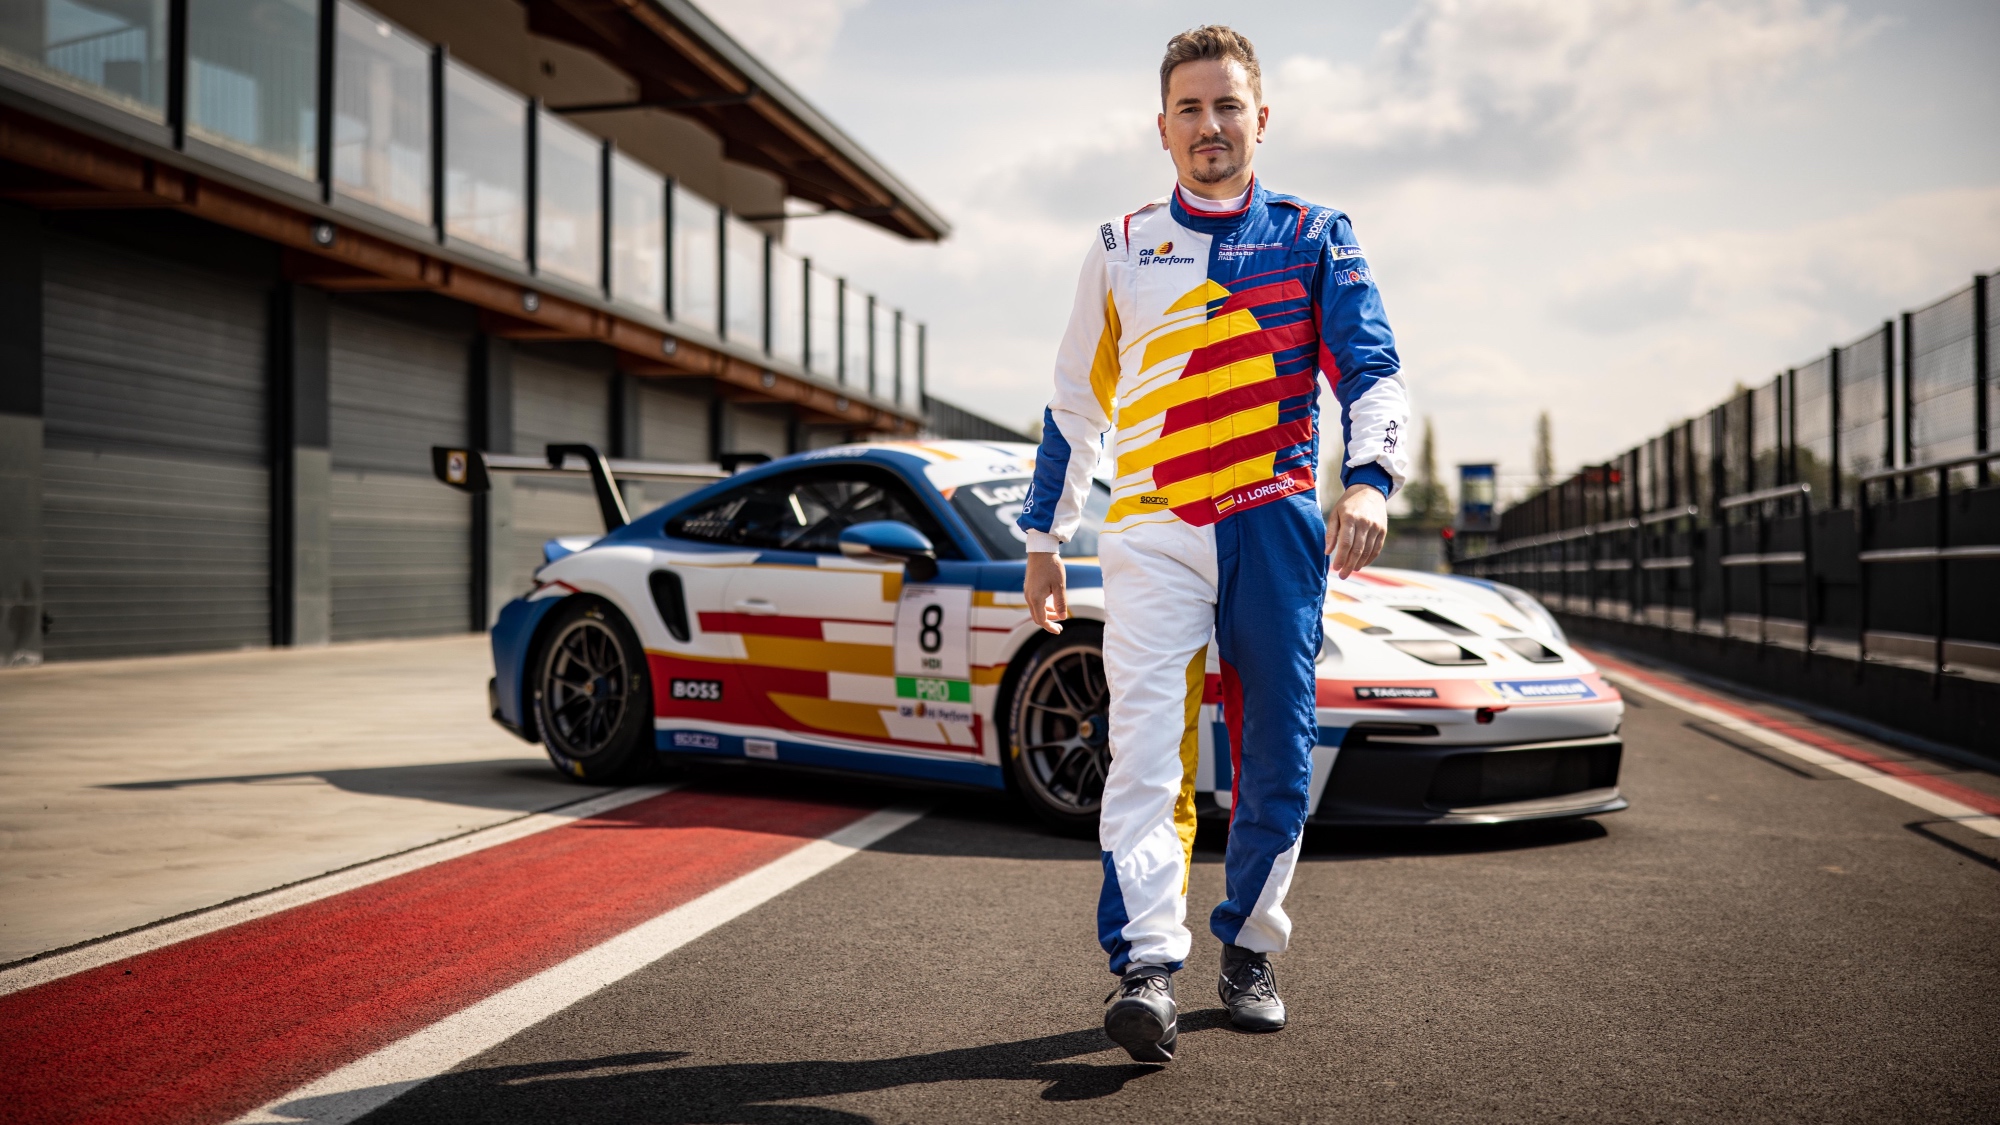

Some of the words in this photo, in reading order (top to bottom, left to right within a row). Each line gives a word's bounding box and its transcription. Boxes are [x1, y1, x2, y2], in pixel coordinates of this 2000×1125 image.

[1139, 256, 1150, 266] Hi
[1152, 255, 1195, 266] Perform
[1140, 495, 1168, 505] sparco
[1236, 493, 1247, 504] J.
[1247, 477, 1295, 501] LORENZO
[919, 604, 944, 655] 8
[672, 680, 721, 700] BOSS
[916, 678, 950, 702] PRO
